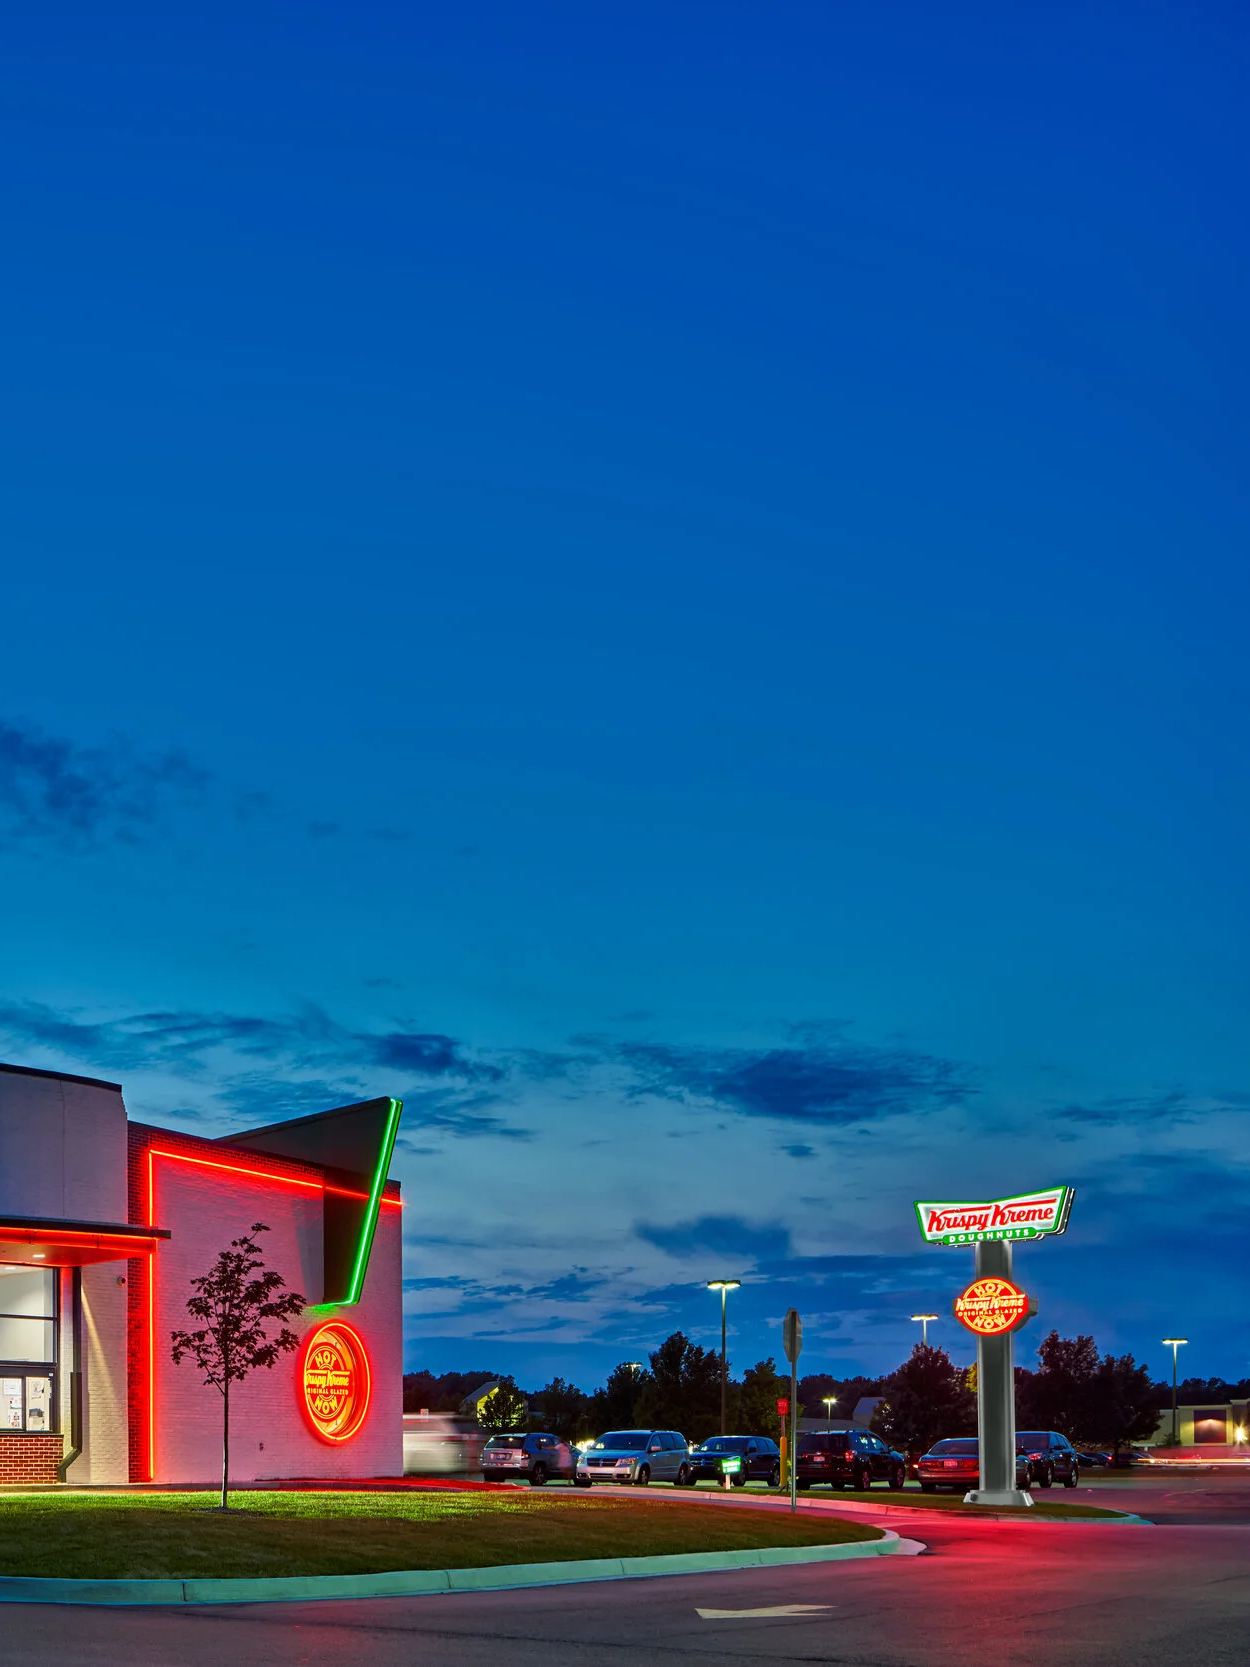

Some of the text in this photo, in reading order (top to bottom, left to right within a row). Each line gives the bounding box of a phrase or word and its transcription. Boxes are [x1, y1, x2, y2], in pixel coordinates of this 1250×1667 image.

[927, 1198, 1057, 1231] Krispy Kreme
[949, 1228, 1030, 1243] DOUGHNUTS
[973, 1283, 1005, 1297] HOT
[955, 1294, 1026, 1312] Krispy Kreme
[972, 1314, 1006, 1329] NOW
[314, 1351, 337, 1367] HOT
[314, 1396, 338, 1414] NOW
